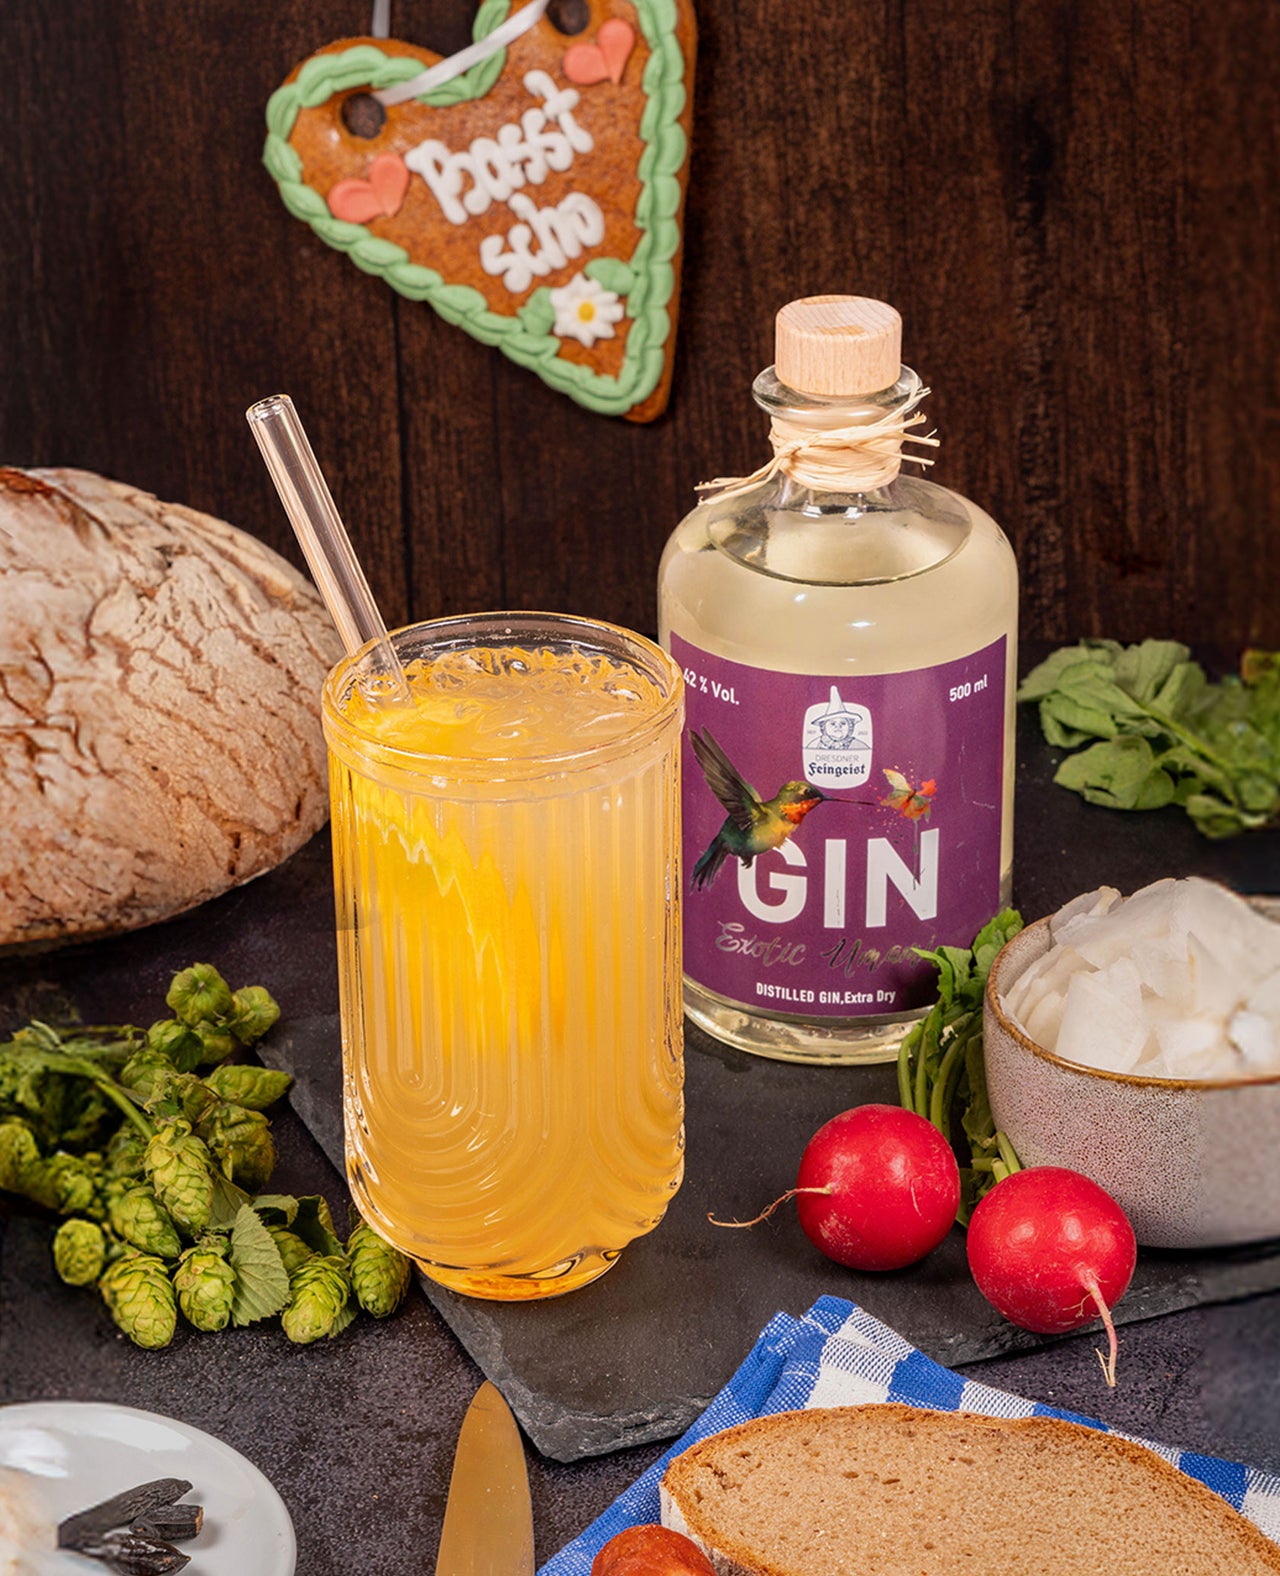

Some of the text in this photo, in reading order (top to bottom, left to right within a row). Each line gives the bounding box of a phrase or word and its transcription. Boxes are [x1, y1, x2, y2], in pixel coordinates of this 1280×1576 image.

[480, 191, 605, 293] scho
[683, 667, 740, 705] 42 % Vol.
[949, 674, 988, 702] 500 ml
[808, 761, 866, 777] Feingeist
[815, 754, 860, 762] DRESDNER
[736, 828, 940, 929] GIN
[715, 920, 806, 967] Exotic
[756, 982, 815, 1003] DISTILLED
[876, 989, 897, 1004] Dry
